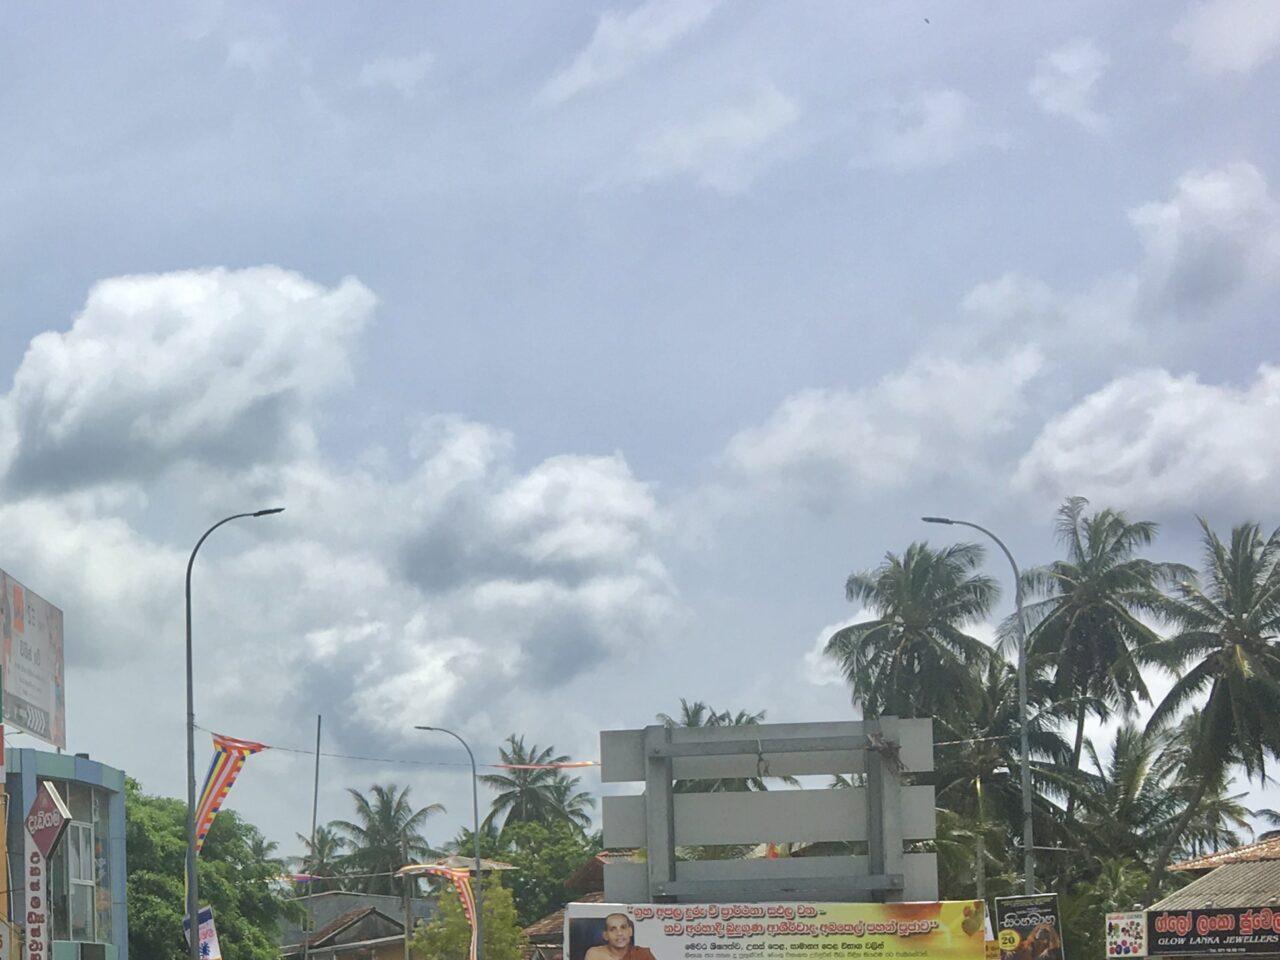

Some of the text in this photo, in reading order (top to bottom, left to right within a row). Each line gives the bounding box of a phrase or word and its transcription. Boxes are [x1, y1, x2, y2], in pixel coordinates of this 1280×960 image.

[1196, 913, 1236, 936] ලංකා
[1001, 936, 1015, 945] 20
[1157, 935, 1279, 945] GLOW LANKA JEWELLERS
